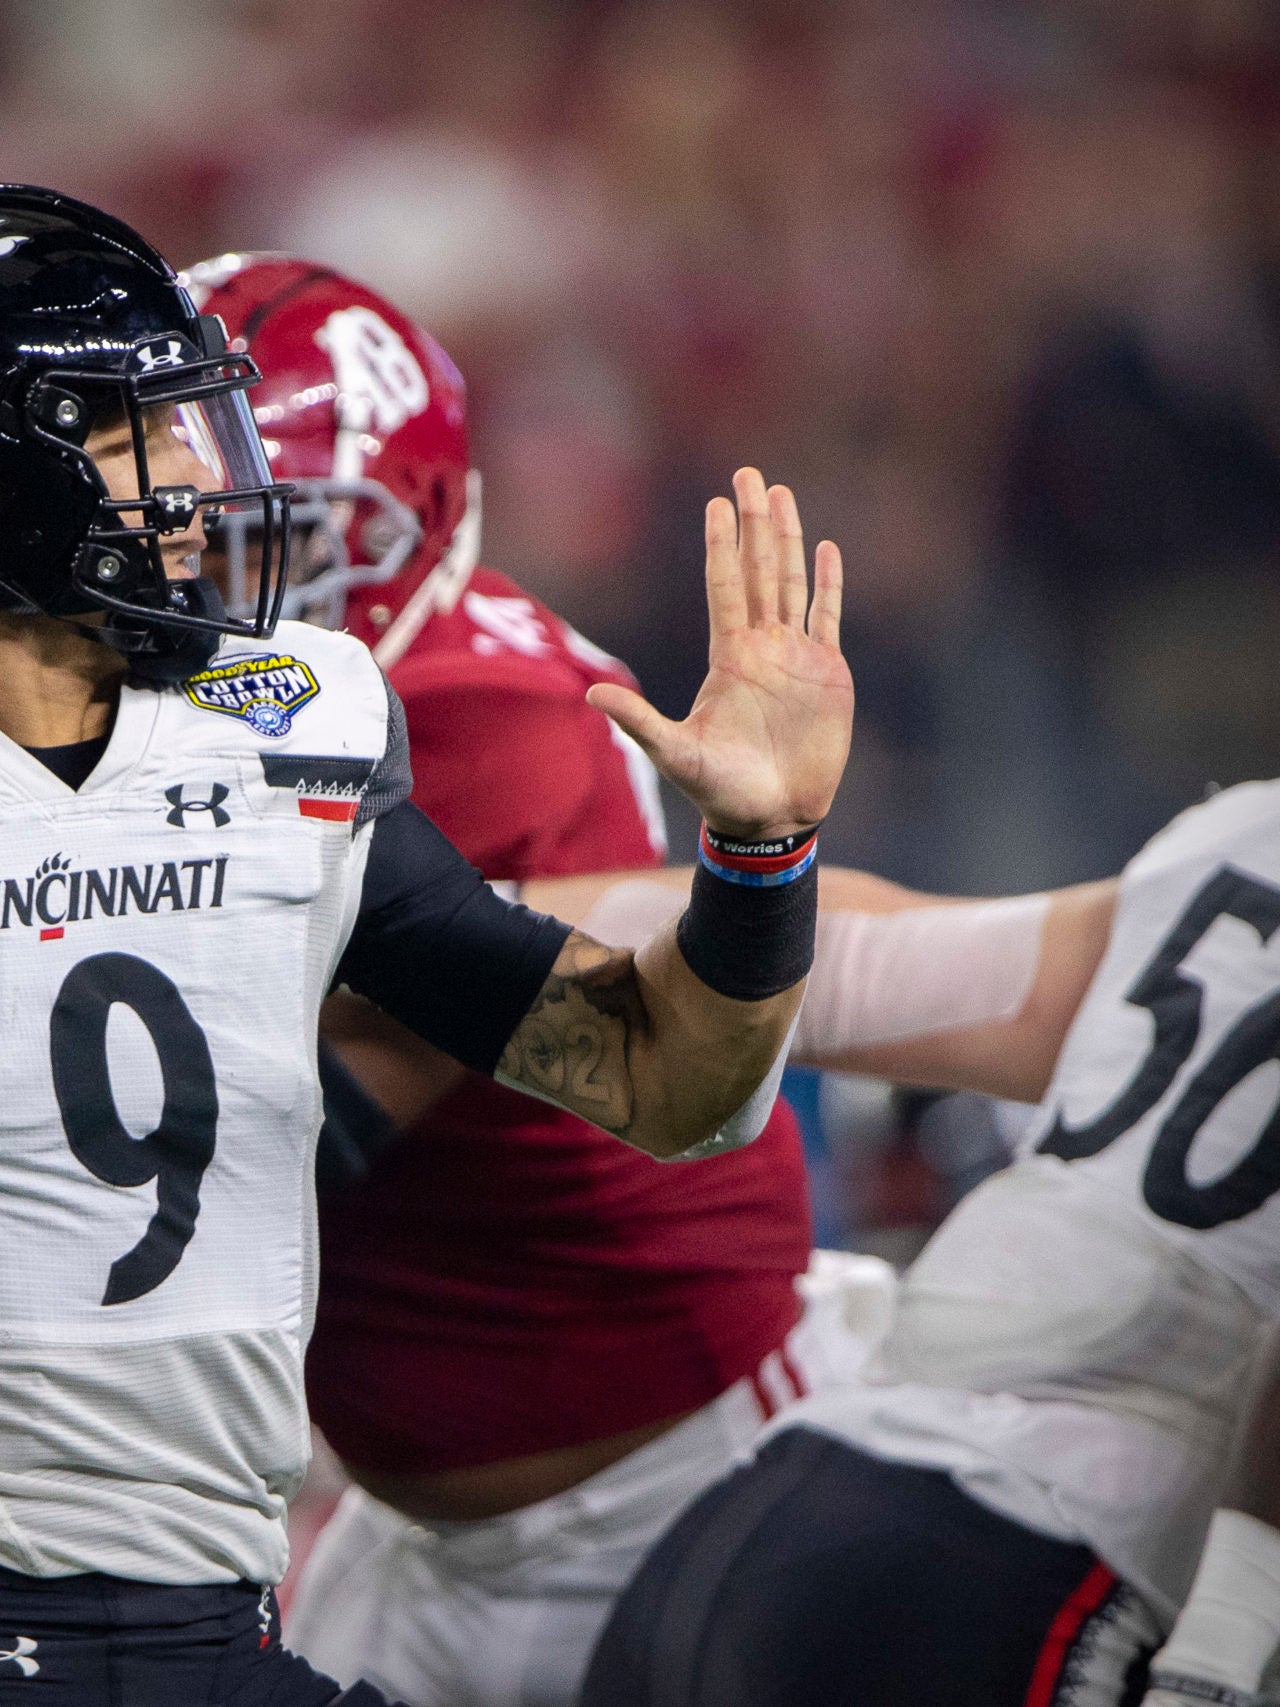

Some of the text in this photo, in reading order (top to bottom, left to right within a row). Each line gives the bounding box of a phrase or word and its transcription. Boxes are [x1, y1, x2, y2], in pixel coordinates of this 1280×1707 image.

[192, 666, 311, 705] COTTON
[220, 686, 294, 709] BOWL
[724, 842, 783, 854] Worries
[1034, 860, 1280, 1229] 56
[49, 950, 219, 1306] 9
